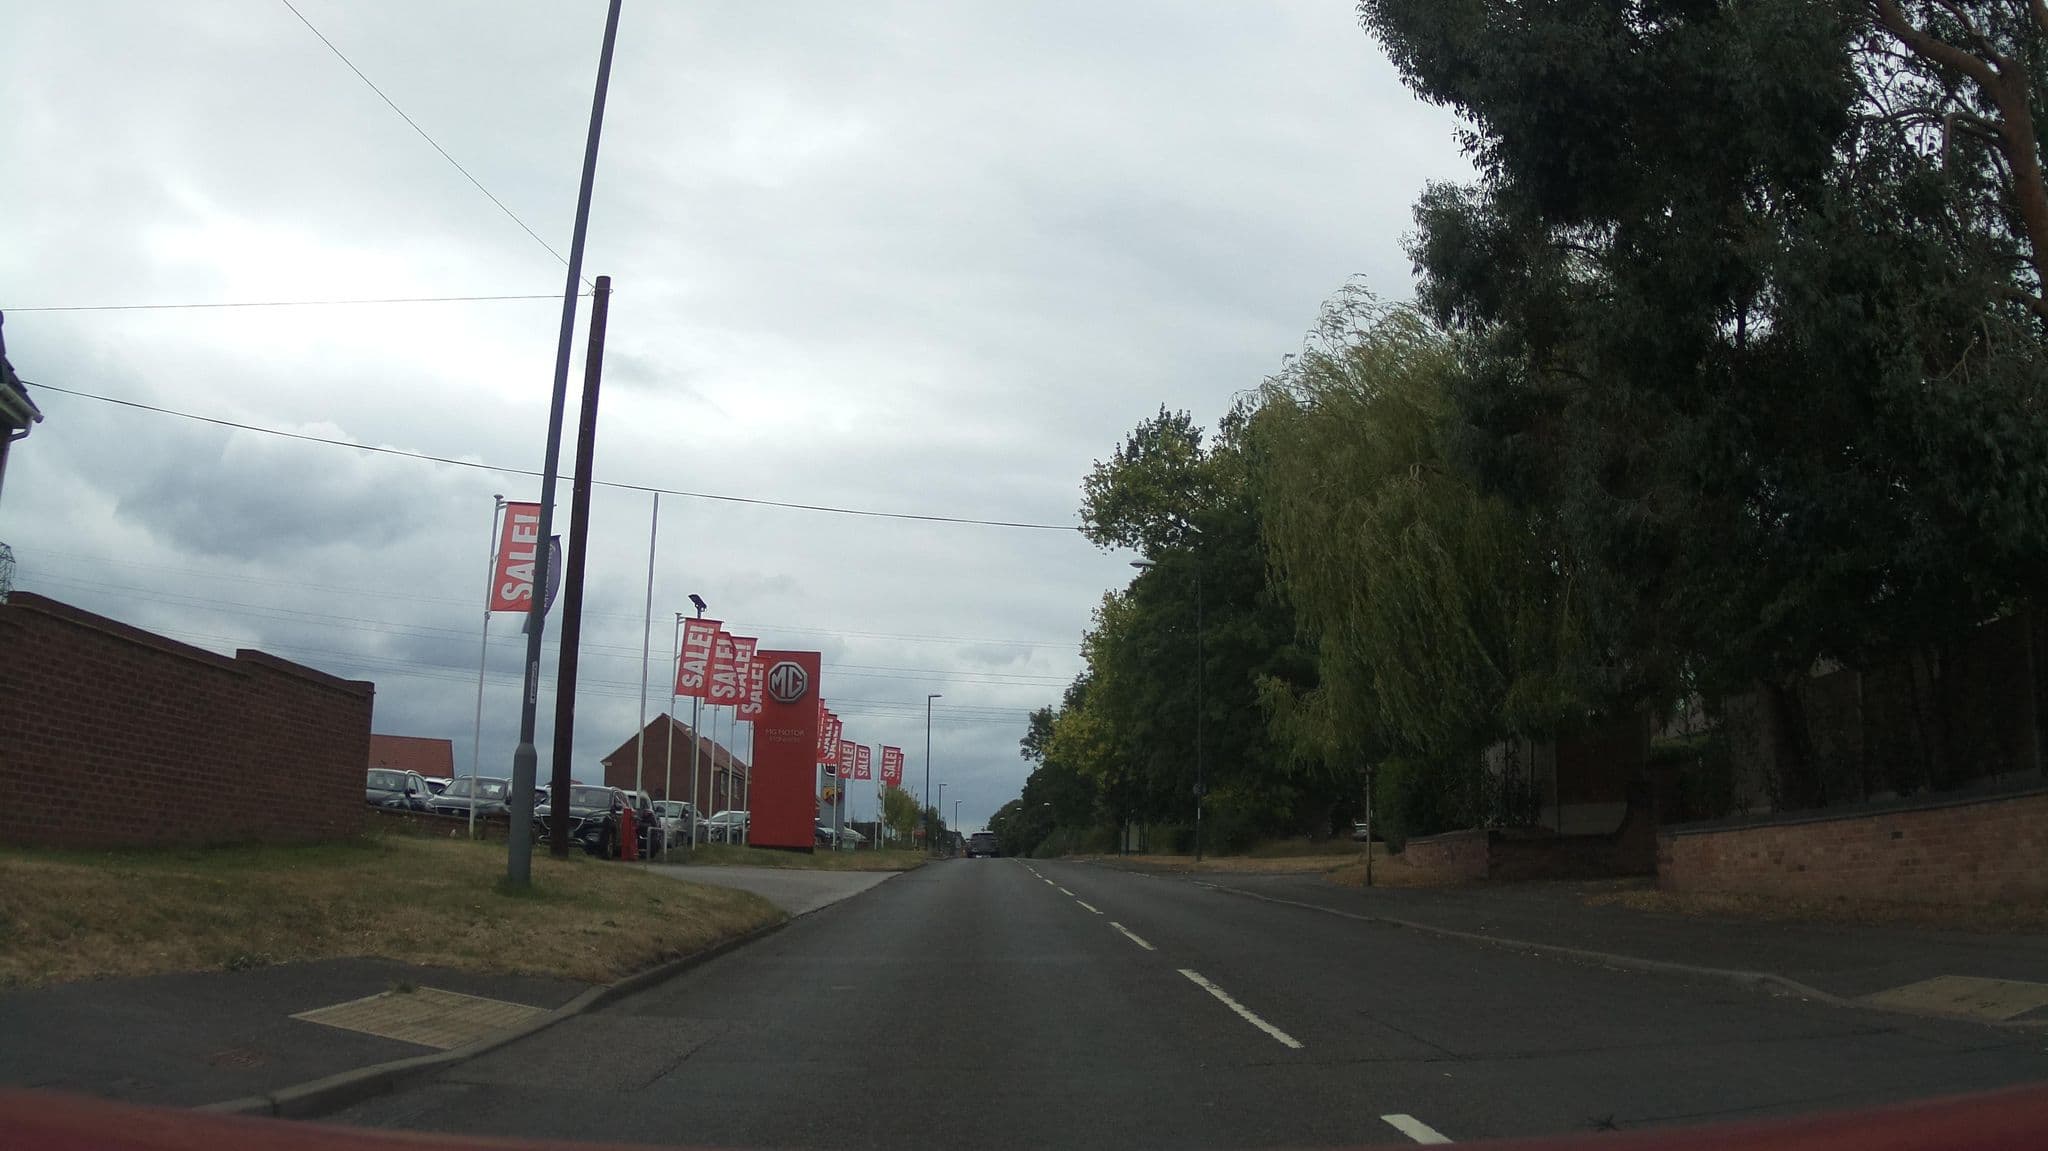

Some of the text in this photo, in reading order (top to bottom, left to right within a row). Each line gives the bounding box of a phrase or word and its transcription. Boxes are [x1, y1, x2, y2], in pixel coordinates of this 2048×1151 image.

[501, 513, 540, 601] SALE!
[682, 625, 714, 689] SALE!
[741, 662, 764, 714] SALE!
[770, 665, 804, 699] MG
[842, 744, 854, 774] SALE!
[858, 748, 869, 776] SALE!
[884, 750, 898, 777] SALE!
